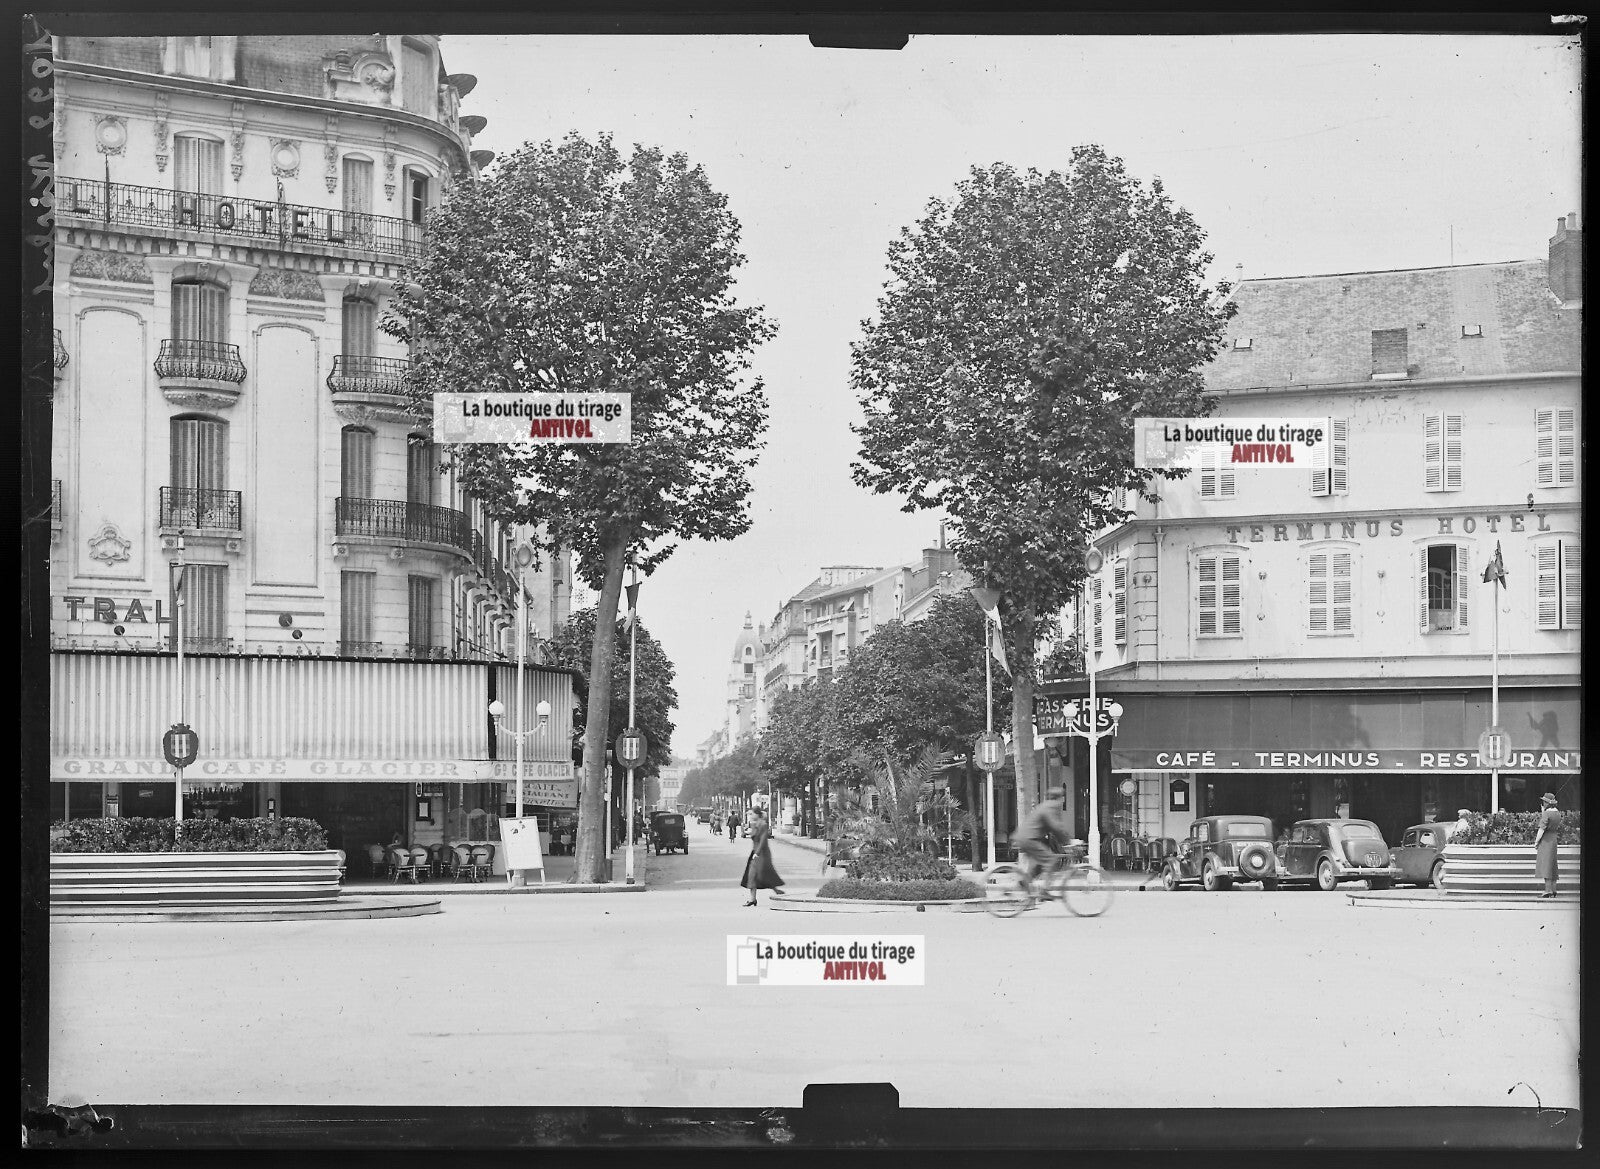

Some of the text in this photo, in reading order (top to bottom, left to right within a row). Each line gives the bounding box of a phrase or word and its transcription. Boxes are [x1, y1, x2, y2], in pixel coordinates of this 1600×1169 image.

[177, 195, 346, 243] HOTEL
[1226, 513, 1551, 544] TERMINUS HOTEL
[51, 595, 173, 624] TRAL
[202, 757, 287, 775] CAFÉ
[310, 761, 459, 776] GLACIER
[512, 762, 534, 777] CFÉ
[537, 764, 571, 777] GLACIER
[1156, 751, 1216, 767] CAFÉ
[1255, 752, 1380, 767] TERMINUS
[1420, 752, 1582, 768] RESTURANT
